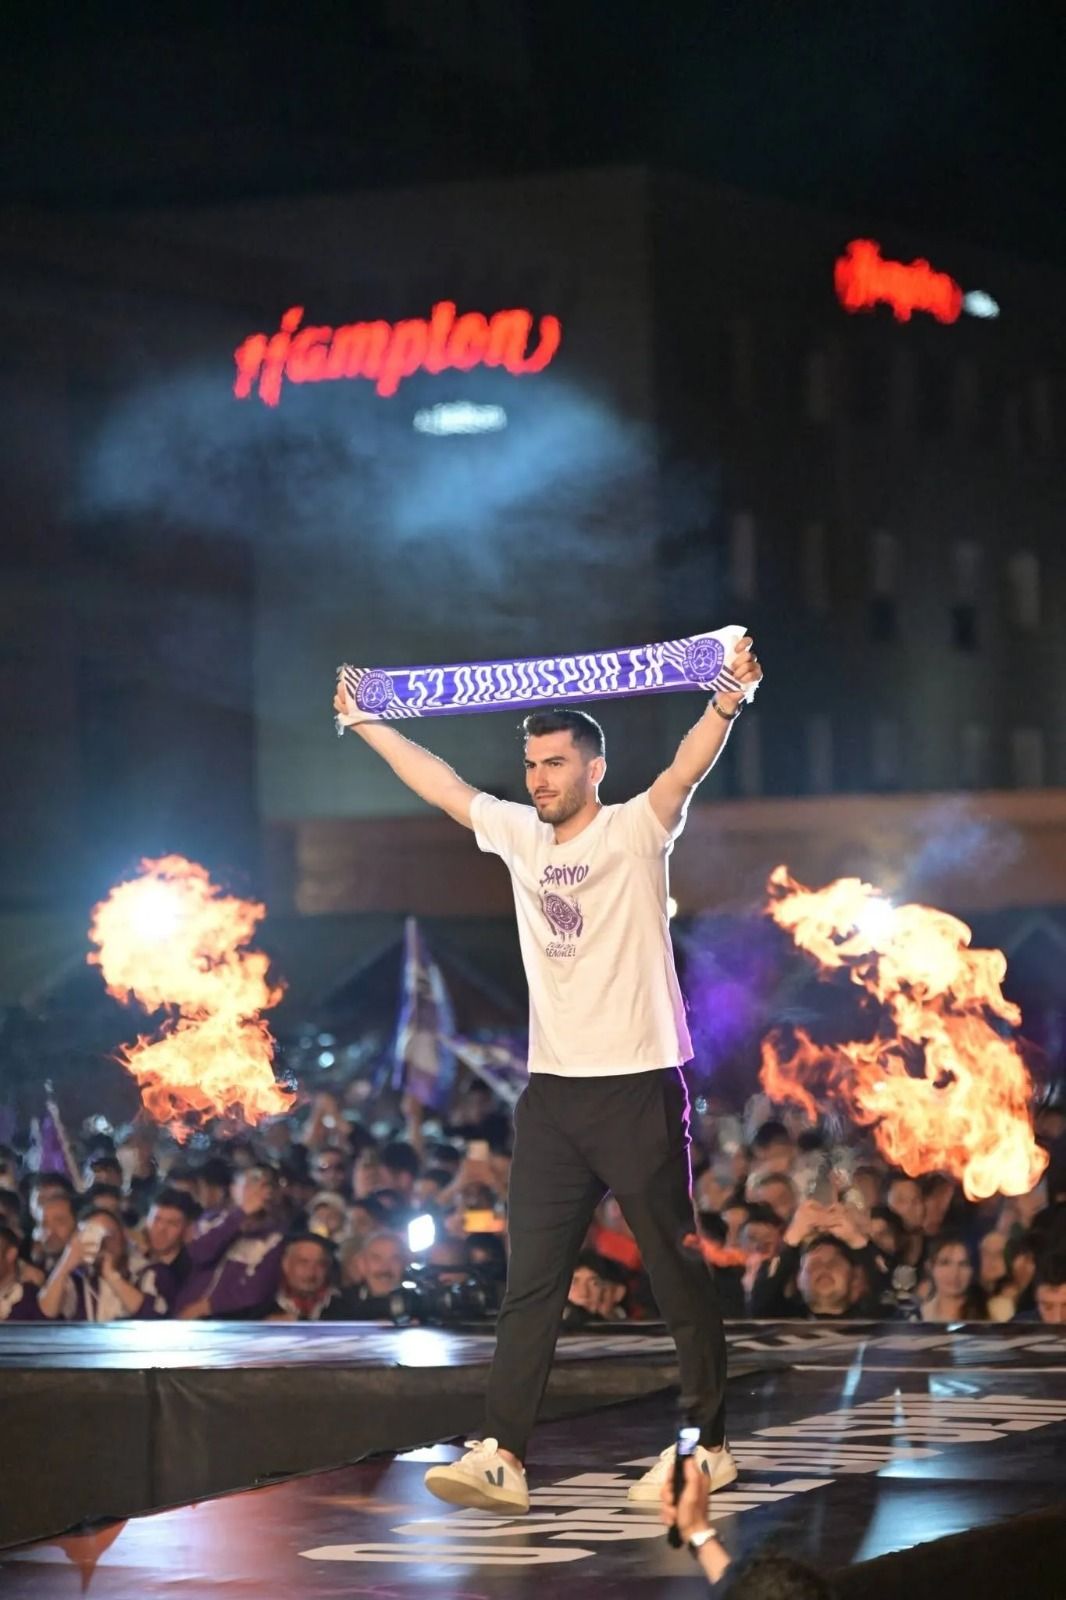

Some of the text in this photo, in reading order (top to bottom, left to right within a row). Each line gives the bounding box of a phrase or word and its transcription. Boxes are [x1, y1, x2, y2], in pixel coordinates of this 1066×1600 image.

[406, 668, 445, 709] 52
[452, 652, 622, 706] ORDUSPOR
[627, 643, 667, 690] FK
